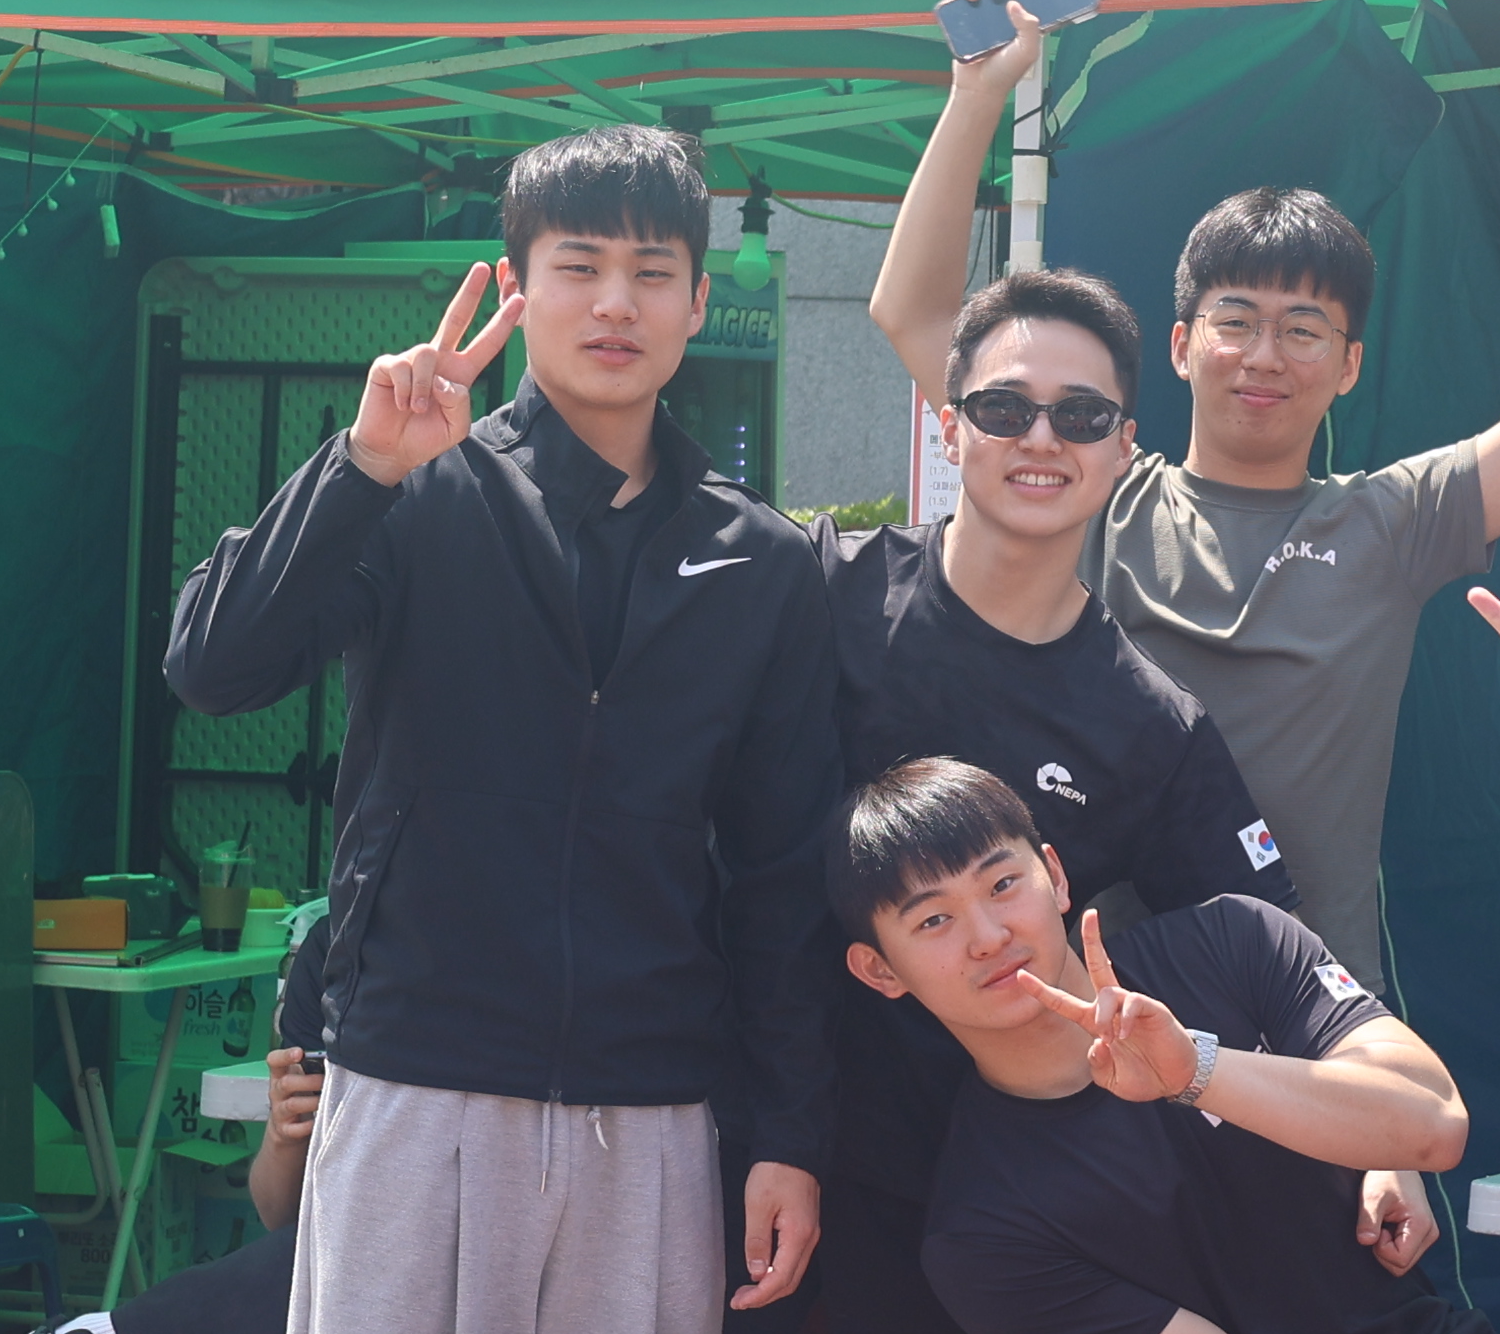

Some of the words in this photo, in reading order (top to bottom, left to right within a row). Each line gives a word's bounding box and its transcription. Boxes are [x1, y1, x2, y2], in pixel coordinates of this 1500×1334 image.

[929, 466, 948, 476] (1.7)
[928, 497, 948, 507] (1.5)
[1264, 540, 1336, 574] R.O.K.A
[1055, 783, 1087, 806] NEPA
[185, 989, 226, 1019] 이슬
[182, 1018, 220, 1036] fresh
[171, 1086, 201, 1133] 참
